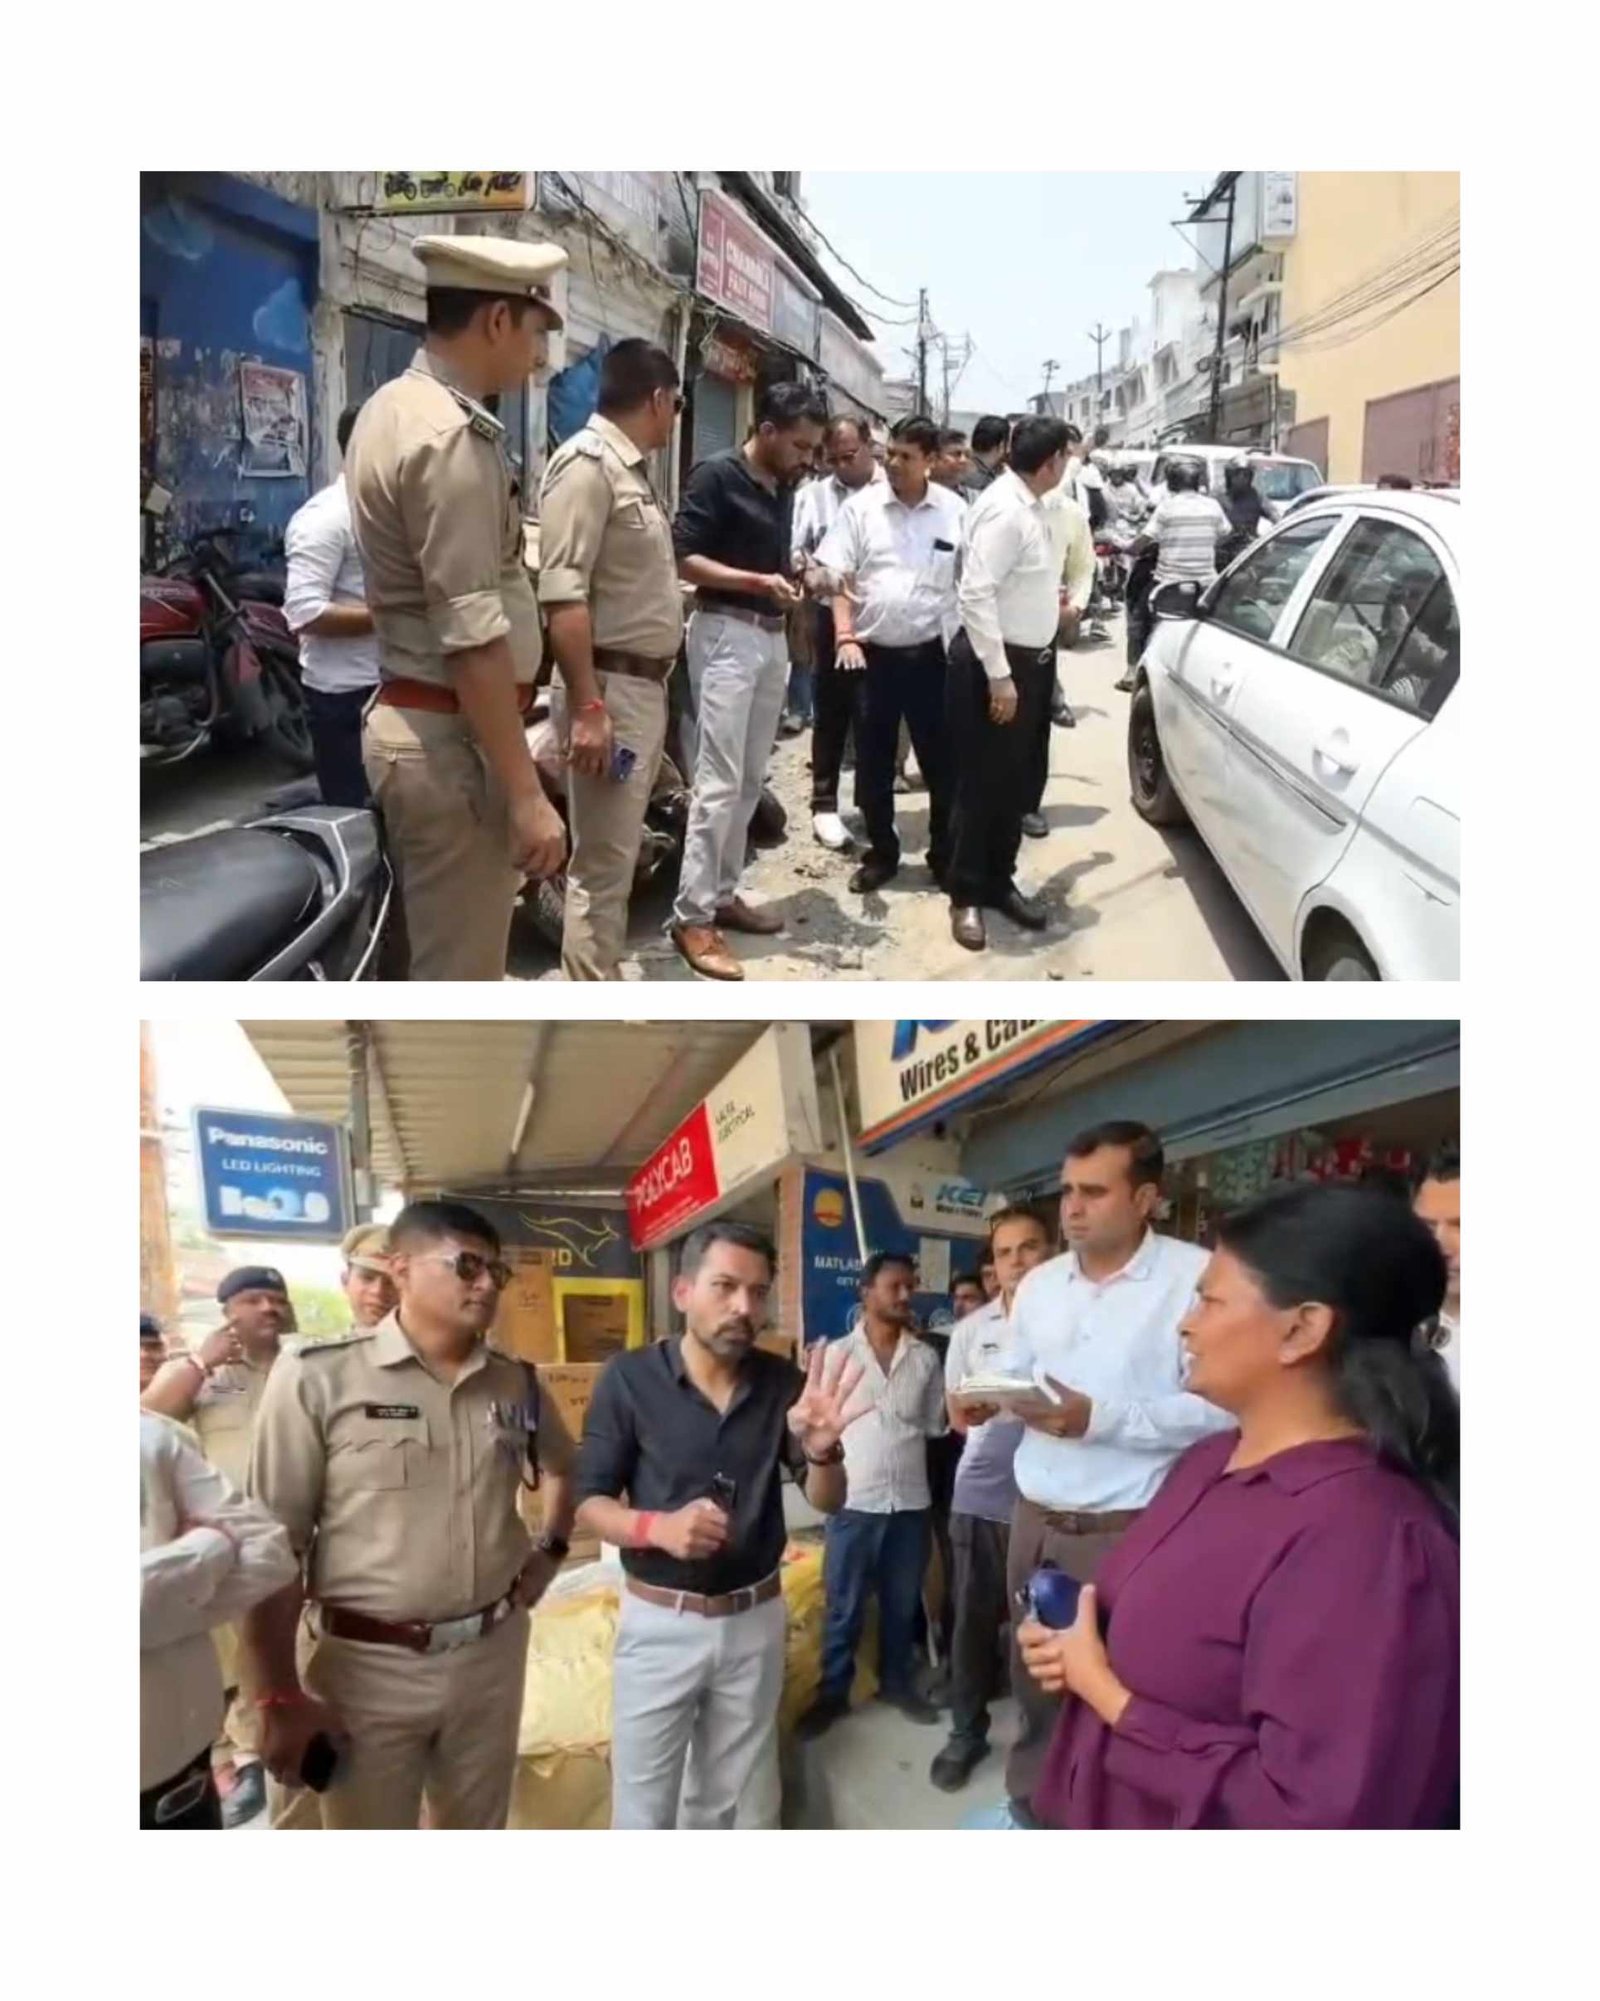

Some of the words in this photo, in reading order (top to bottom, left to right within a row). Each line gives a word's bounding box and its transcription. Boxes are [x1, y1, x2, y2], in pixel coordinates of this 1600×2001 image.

[900, 1045, 959, 1101] Wires
[964, 1032, 980, 1063] &
[207, 1126, 329, 1155] Panasonic
[222, 1158, 251, 1171] LED
[254, 1161, 322, 1177] LIGHTING
[633, 1136, 693, 1215] POLYCAB
